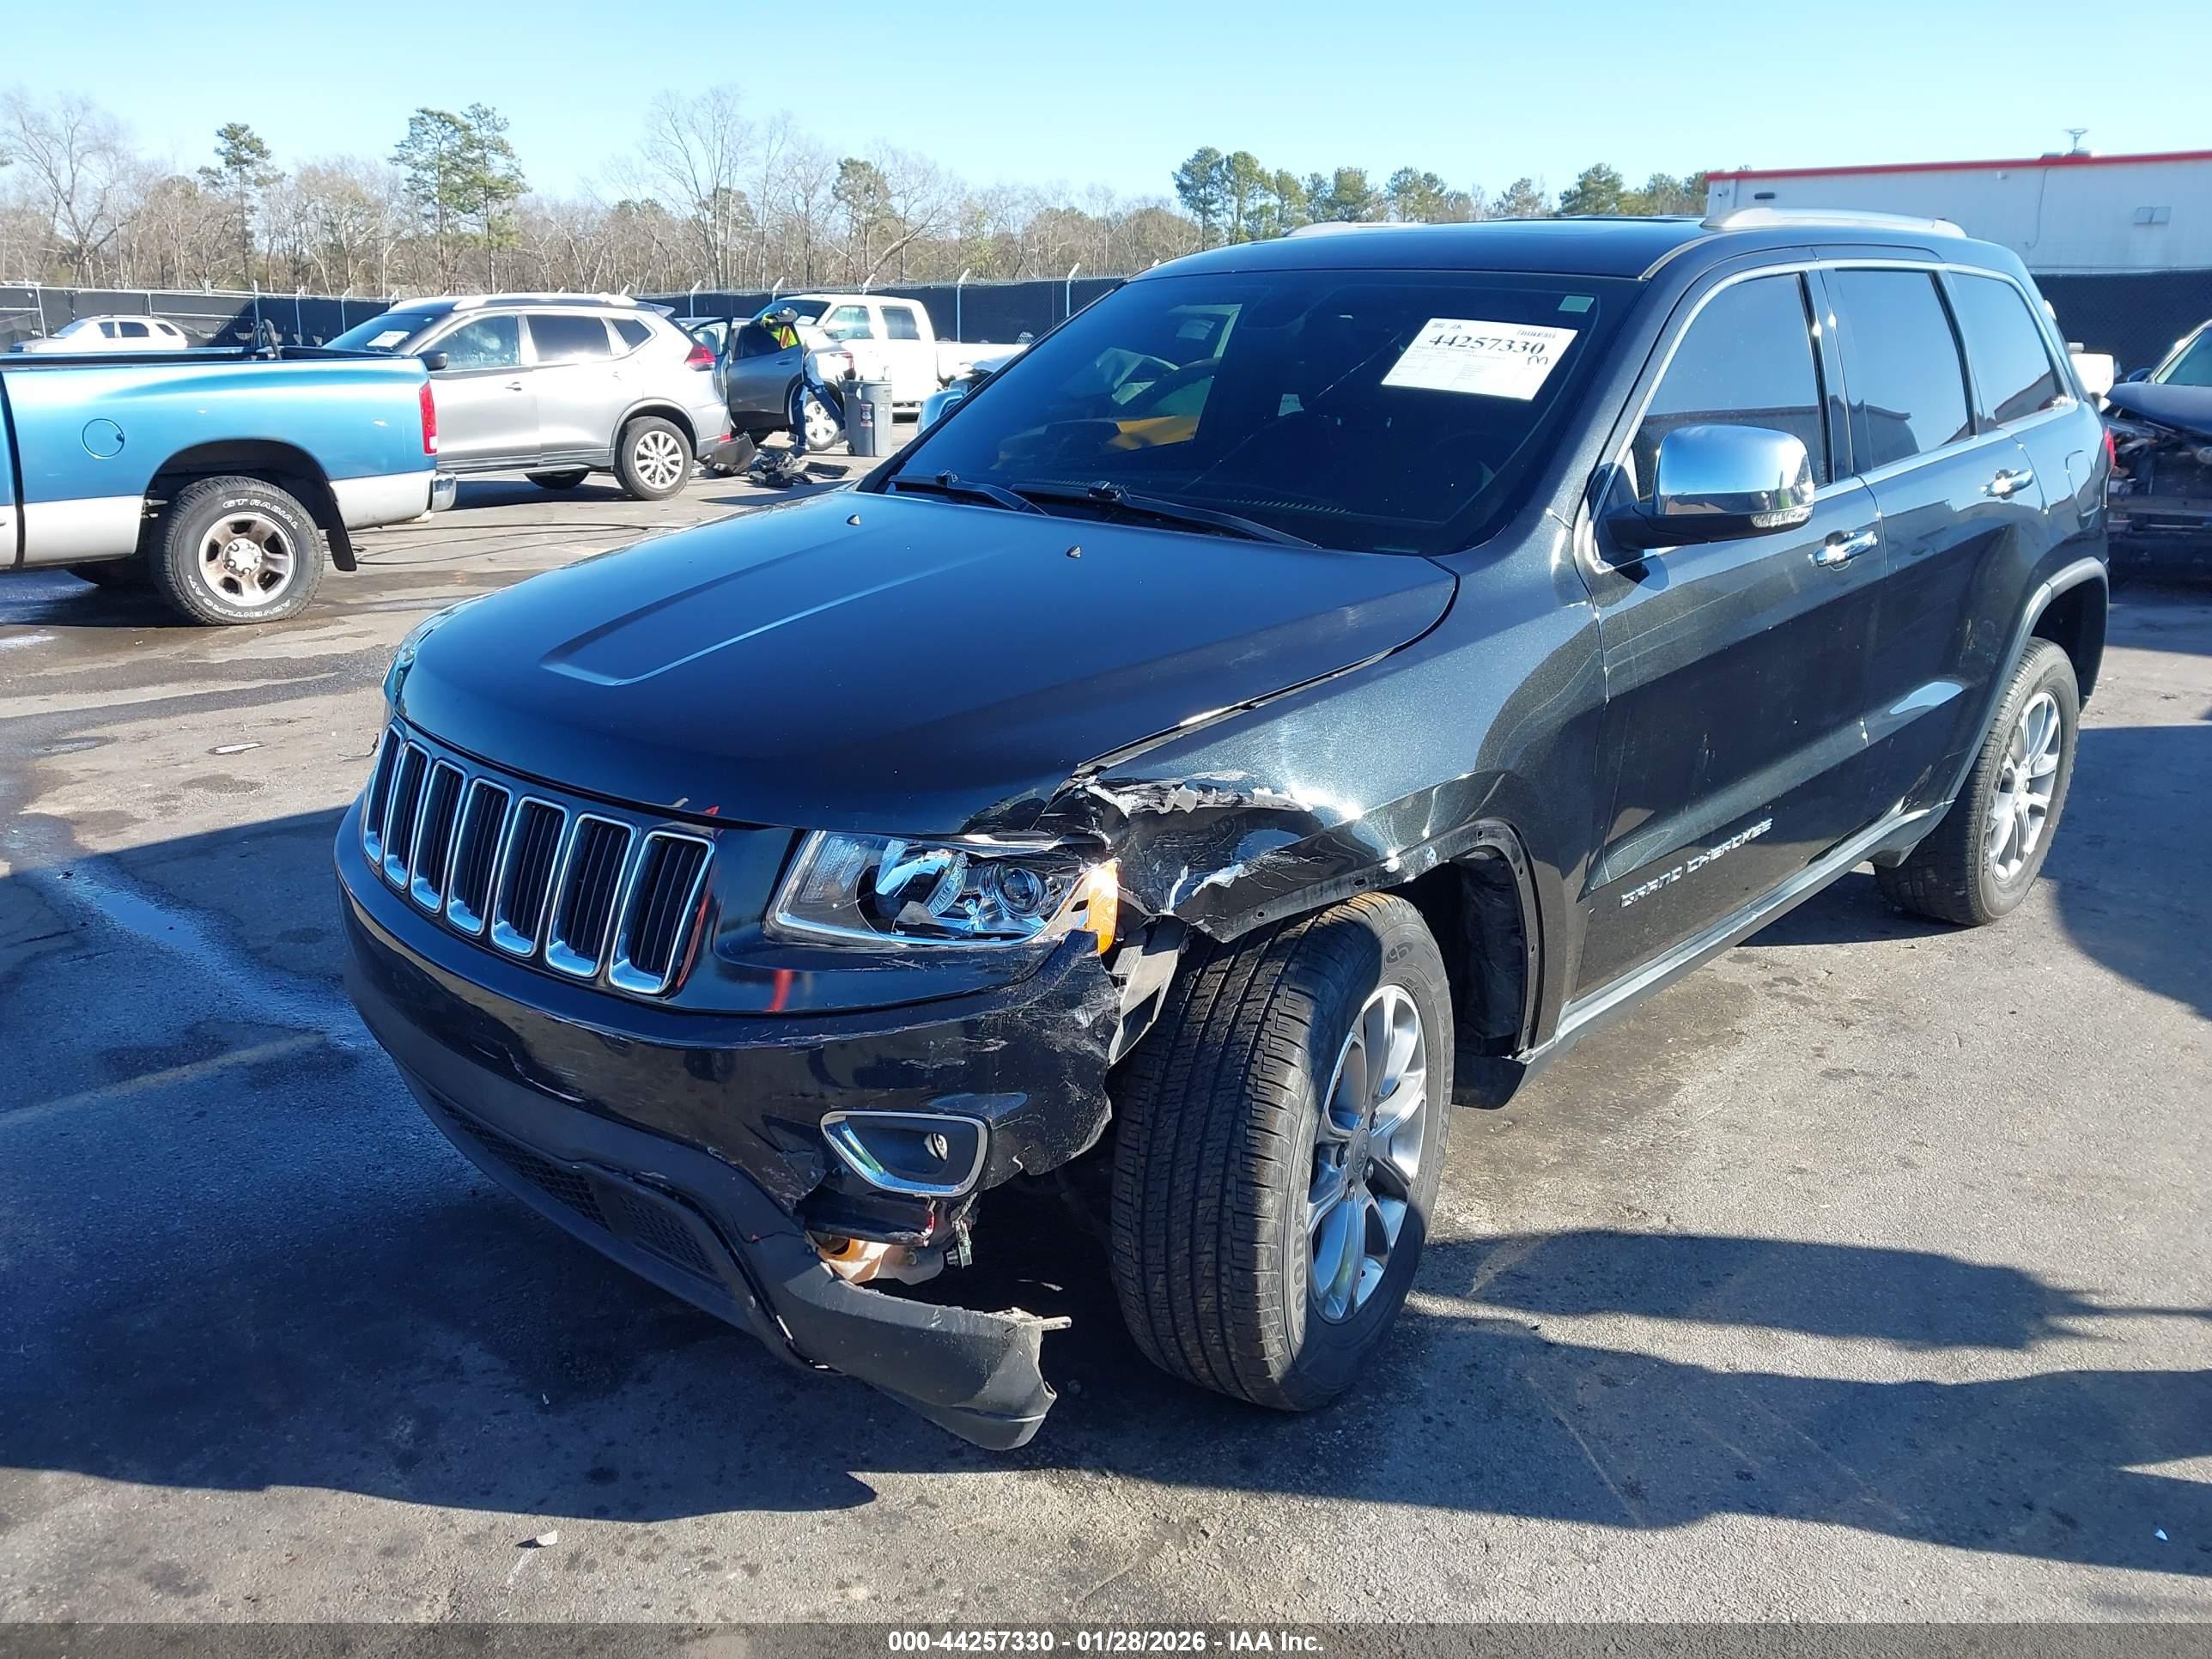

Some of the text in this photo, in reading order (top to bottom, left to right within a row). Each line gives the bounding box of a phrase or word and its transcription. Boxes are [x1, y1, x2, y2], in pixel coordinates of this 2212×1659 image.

[1429, 334, 1545, 355] 44257330
[222, 498, 298, 530] GT RADIAL
[203, 598, 291, 618] ADVENTURO
[1620, 817, 1773, 908] GRAND CHEROKEE
